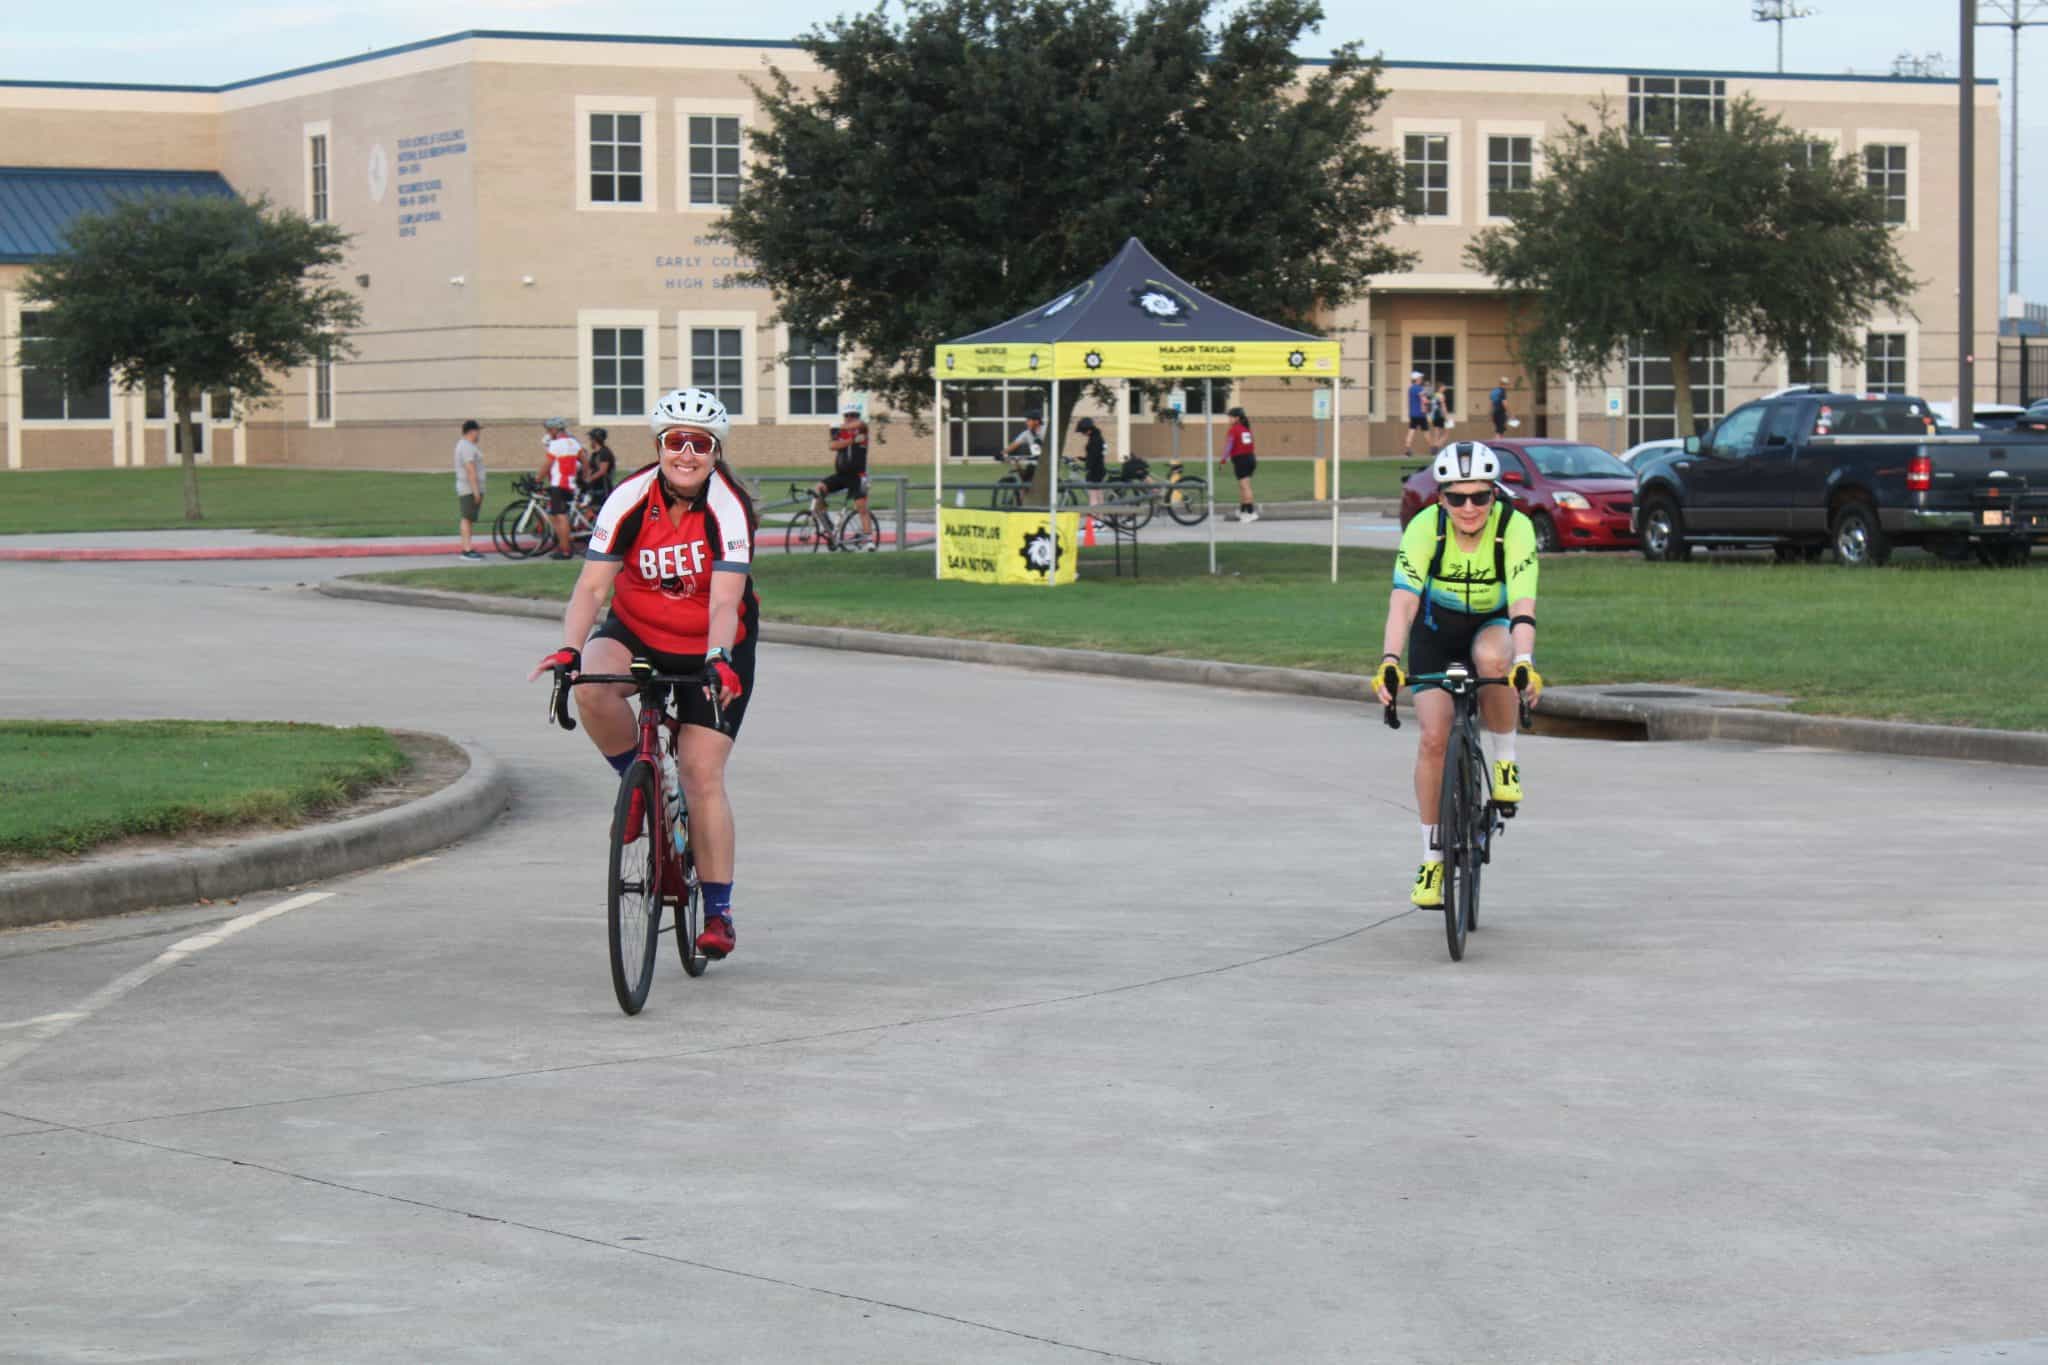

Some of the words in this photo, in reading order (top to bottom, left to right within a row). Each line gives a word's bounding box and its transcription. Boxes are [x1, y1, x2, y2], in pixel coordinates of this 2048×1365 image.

[656, 256, 701, 267] EARLY
[666, 279, 702, 289] HIGH
[1159, 345, 1196, 353] MAJOR
[1199, 345, 1236, 353] TAYLOR
[1162, 364, 1183, 372] SAN
[1186, 364, 1232, 372] ANTONIO
[640, 541, 705, 580] BEEF
